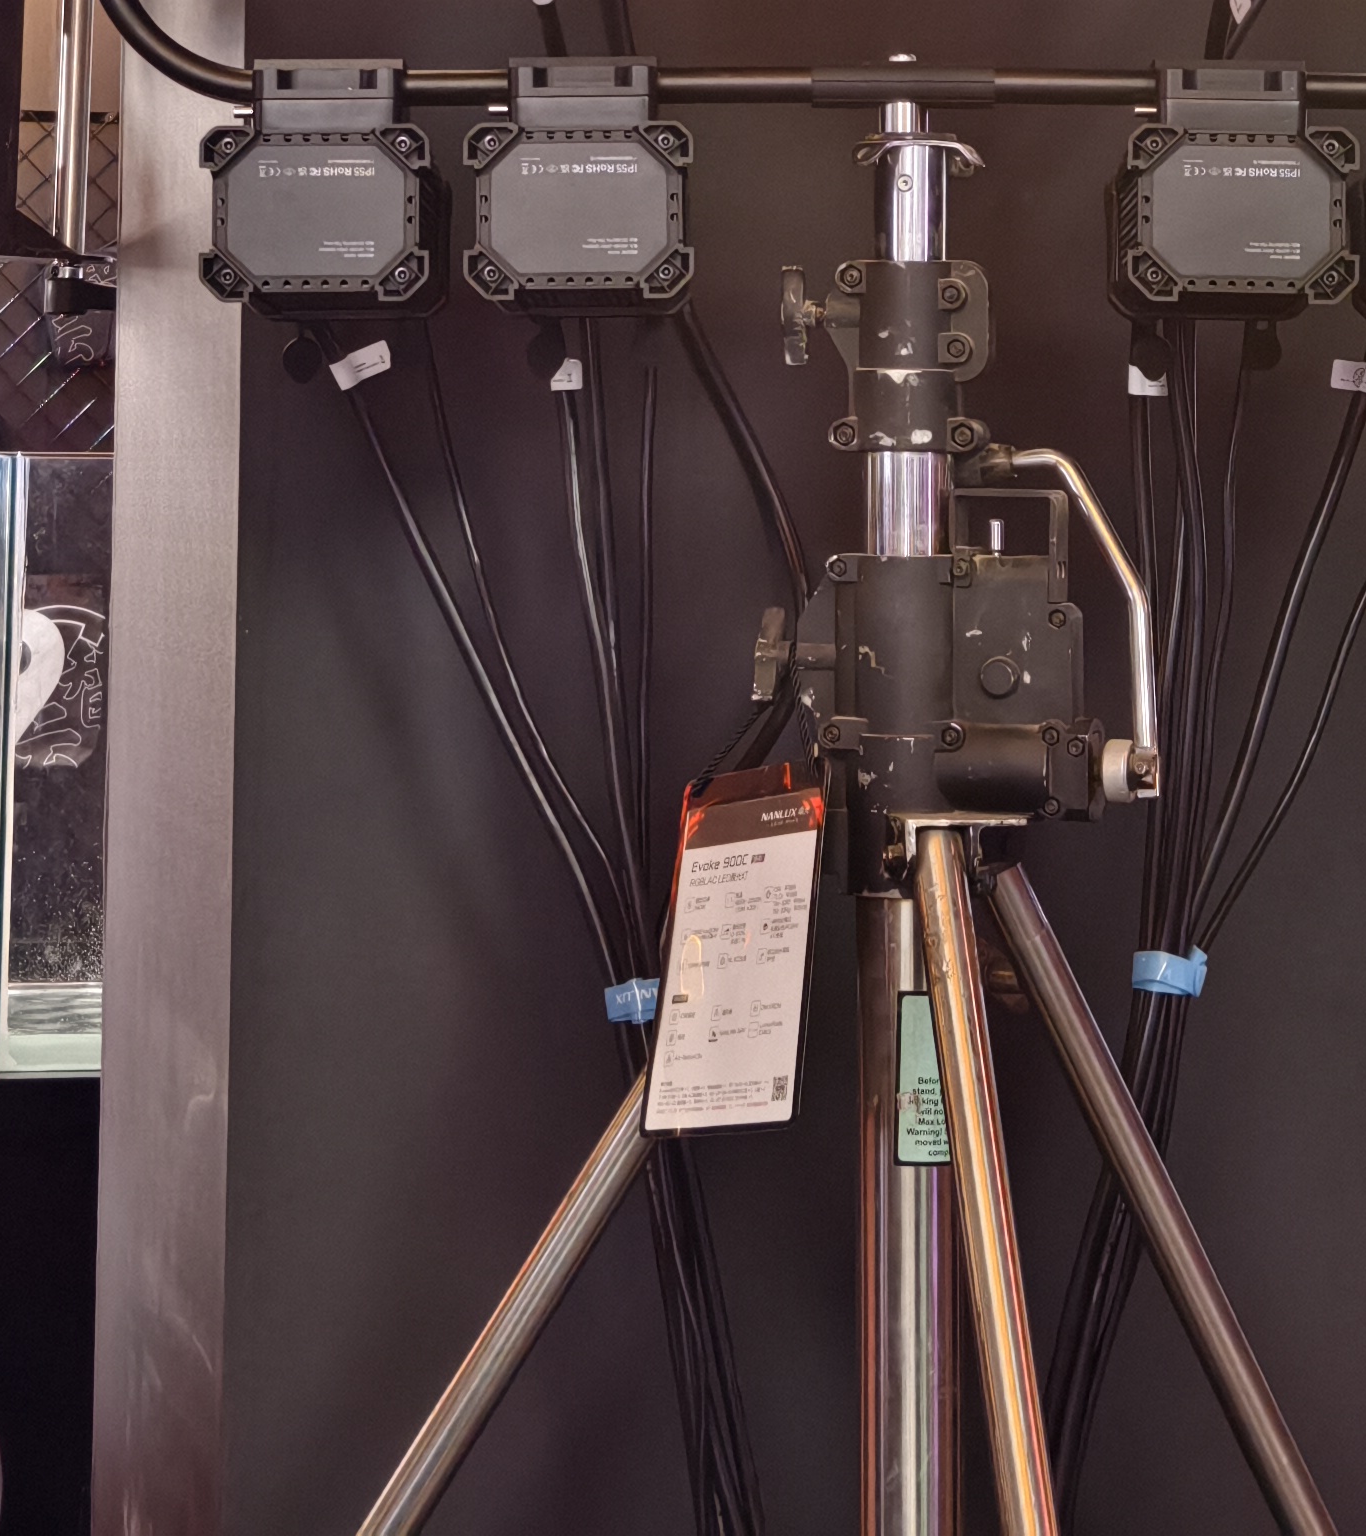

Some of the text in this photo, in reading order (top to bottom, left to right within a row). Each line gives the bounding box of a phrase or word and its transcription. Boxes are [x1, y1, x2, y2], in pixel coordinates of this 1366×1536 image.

[323, 167, 352, 176] RoHS
[354, 167, 375, 176] IP55
[585, 164, 614, 173] RoHS
[616, 164, 638, 173] IP55
[1248, 167, 1277, 177] RoHS
[1279, 168, 1301, 178] IP55
[761, 808, 798, 822] NANLUX
[691, 860, 721, 873] Evoke
[918, 1076, 940, 1085] Befor
[918, 1118, 935, 1126] Max
